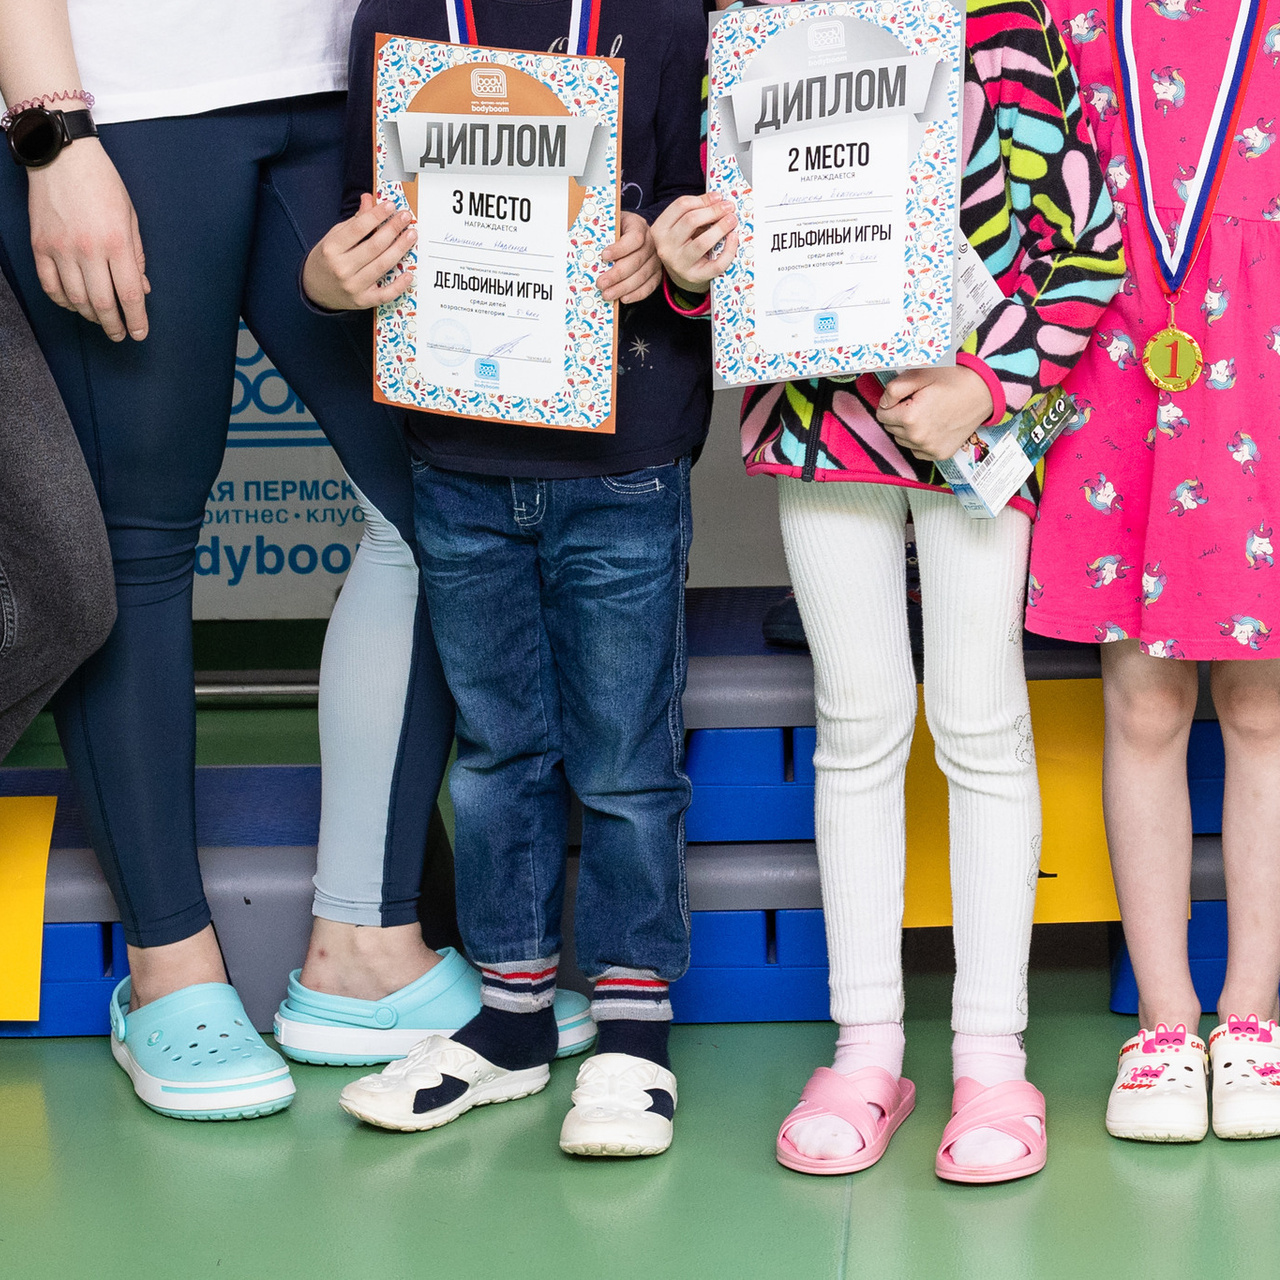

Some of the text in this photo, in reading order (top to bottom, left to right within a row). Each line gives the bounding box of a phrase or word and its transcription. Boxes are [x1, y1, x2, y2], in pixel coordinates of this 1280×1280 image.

[471, 105, 509, 113] bodyboom
[754, 65, 907, 135] ДИПЛОМ
[420, 121, 566, 168] ДИПЛОМ
[788, 142, 870, 173] 2 МЕСТО
[801, 172, 856, 183] НАГРАЖДАЕТСЯ
[452, 190, 531, 222] 3 МЕСТО
[464, 221, 518, 232] НАГРАЖДАЕТСЯ
[771, 224, 891, 253] ДЕЛЬФИНЬИ ИГРЫ
[434, 271, 552, 300] ДЕЛЬФИНЬИ ИГРЫ
[1164, 340, 1181, 378] 1
[244, 479, 357, 501] ПЕРМСК
[194, 535, 359, 586] dyboo
